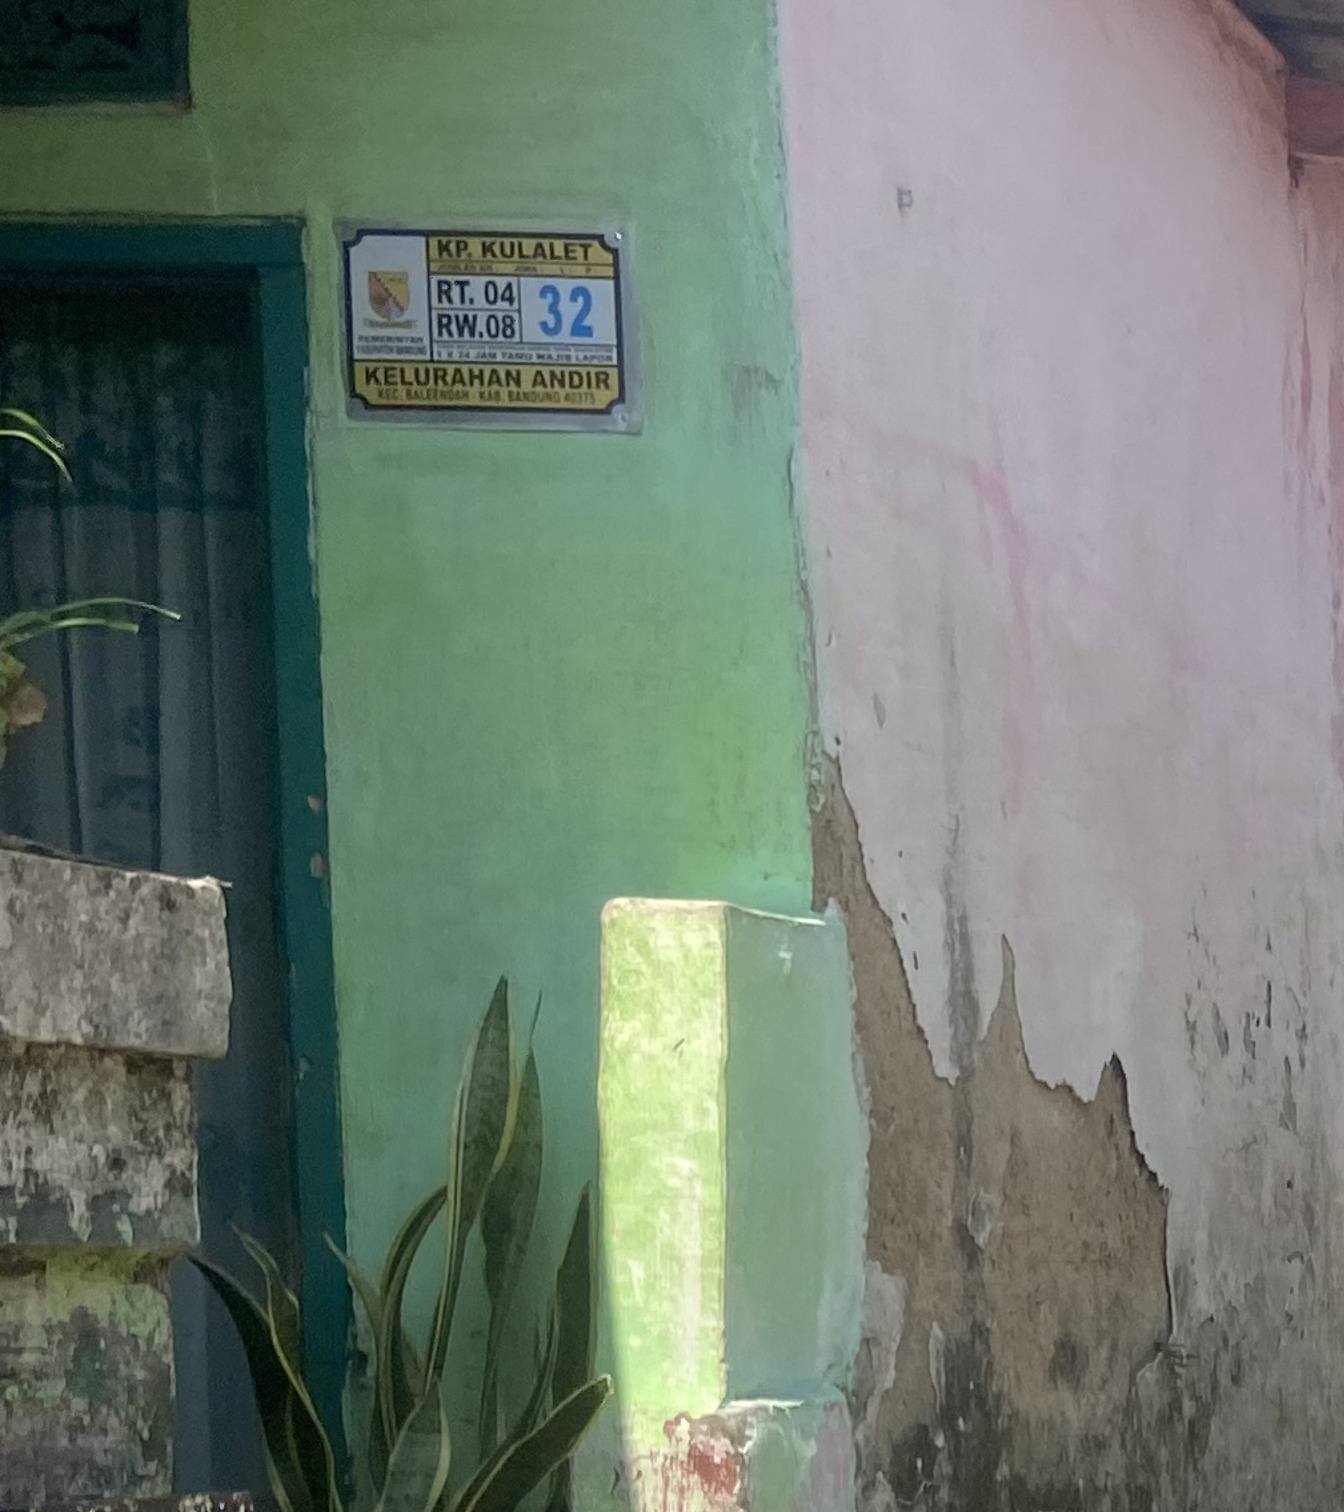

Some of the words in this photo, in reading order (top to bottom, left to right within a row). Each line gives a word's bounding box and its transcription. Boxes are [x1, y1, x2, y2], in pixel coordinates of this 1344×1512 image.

[437, 239, 473, 260] KP.
[481, 240, 593, 261] KULALET
[436, 279, 474, 305] RT.
[484, 280, 516, 307] 04
[538, 284, 594, 338] 32
[436, 312, 516, 339] RW.08
[365, 365, 522, 389] KELURAHAN
[531, 369, 611, 391] ANDIR
